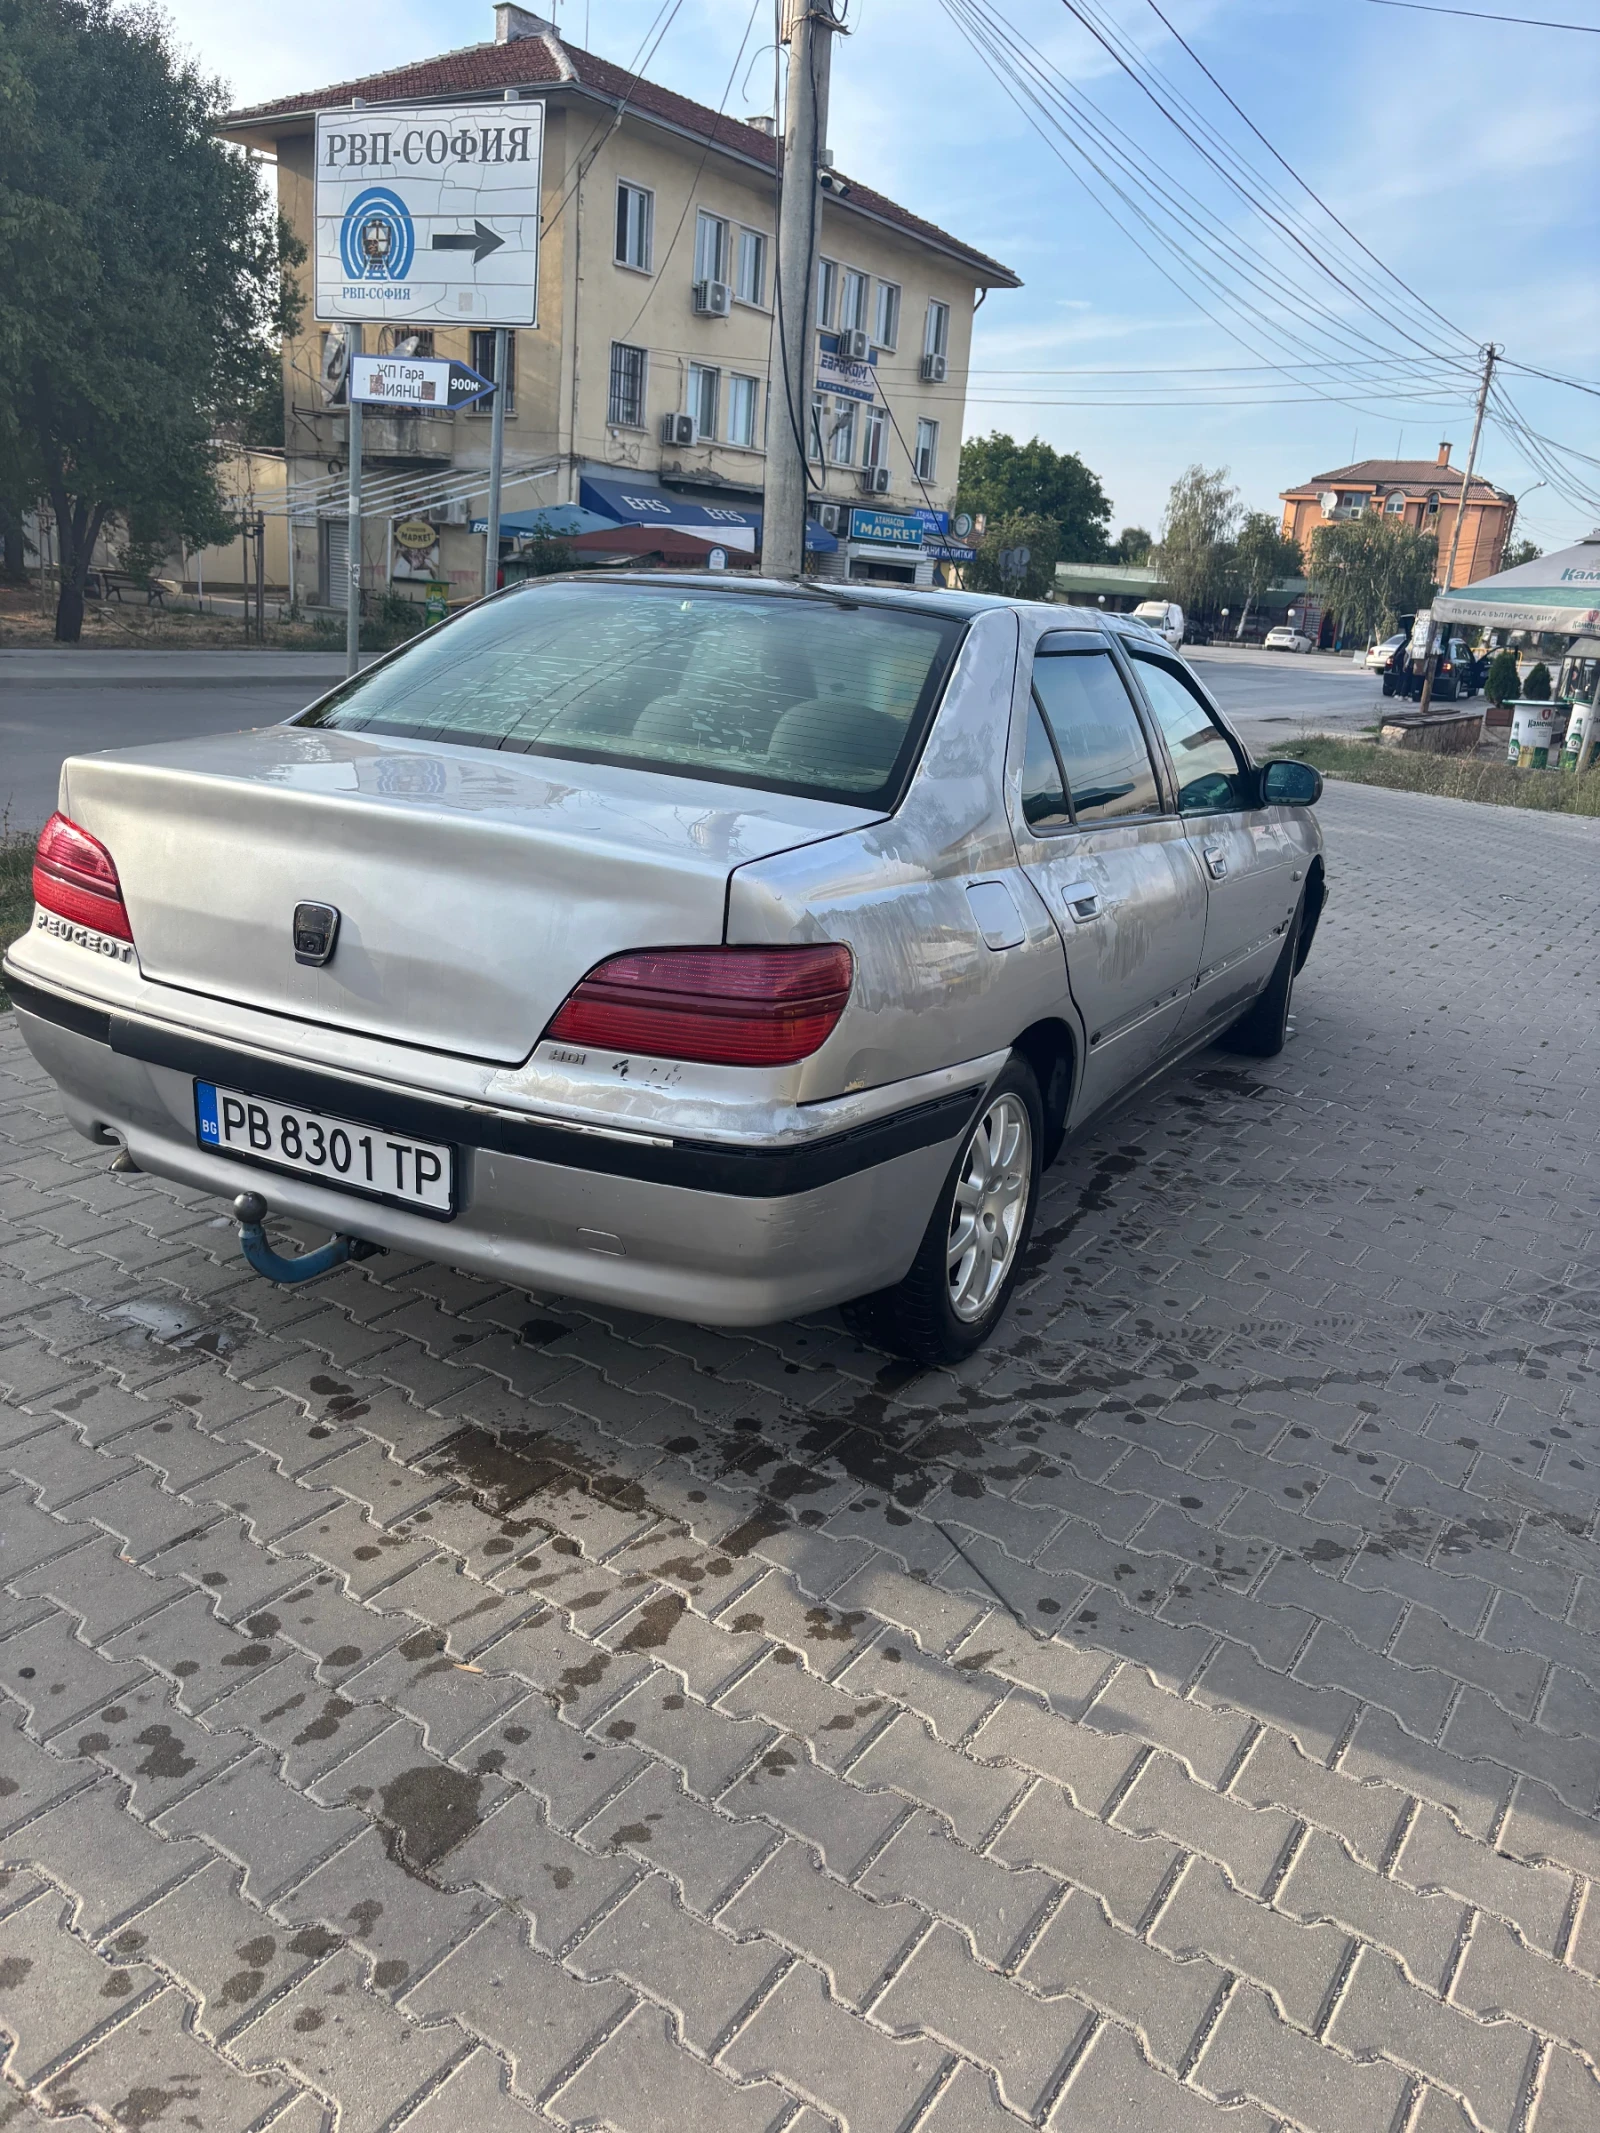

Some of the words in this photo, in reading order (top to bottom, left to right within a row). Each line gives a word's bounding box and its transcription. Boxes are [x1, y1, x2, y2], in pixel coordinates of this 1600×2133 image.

[326, 126, 532, 167] РВП-СОФИЯ
[342, 286, 411, 301] РВП-СОФИЯ
[377, 364, 396, 379] ЖП
[399, 365, 424, 382] Гара
[370, 379, 434, 402] ИЯНЦ
[621, 495, 671, 514] EFES
[701, 506, 747, 524] EFES
[874, 515, 905, 528] АТАНАСОВ
[1452, 607, 1487, 617] ПЪРВАТА
[1488, 611, 1534, 621] БЪЛГАРСКА
[1536, 614, 1557, 622] БИРА
[36, 912, 132, 964] PEUGEOT
[202, 1118, 218, 1136] BG
[280, 1114, 374, 1182] 8301
